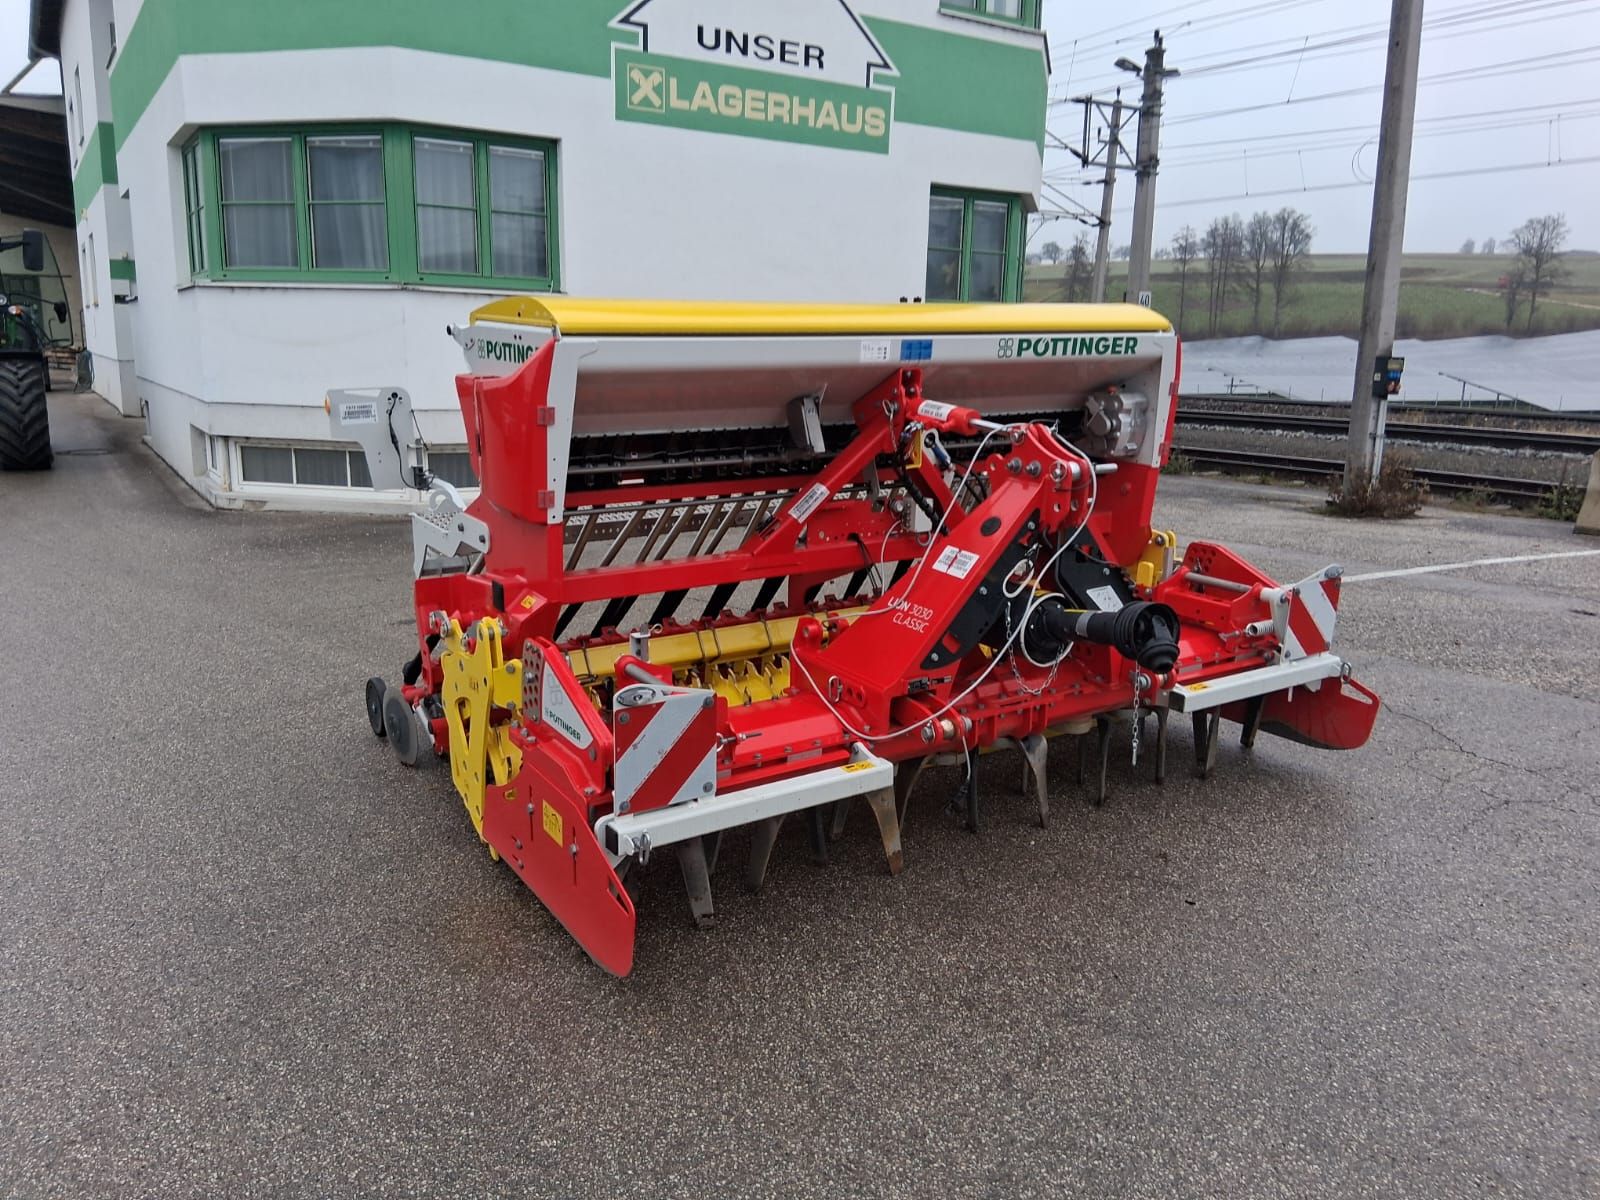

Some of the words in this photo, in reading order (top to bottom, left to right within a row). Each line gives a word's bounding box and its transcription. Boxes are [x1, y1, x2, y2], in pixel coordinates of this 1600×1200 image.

[697, 24, 825, 69] UNSER
[669, 77, 886, 137] LAGERHAUS
[1017, 336, 1138, 357] PÖTTINGER
[888, 596, 911, 612] LION
[909, 603, 934, 620] 3030
[893, 612, 929, 634] CLASSIC
